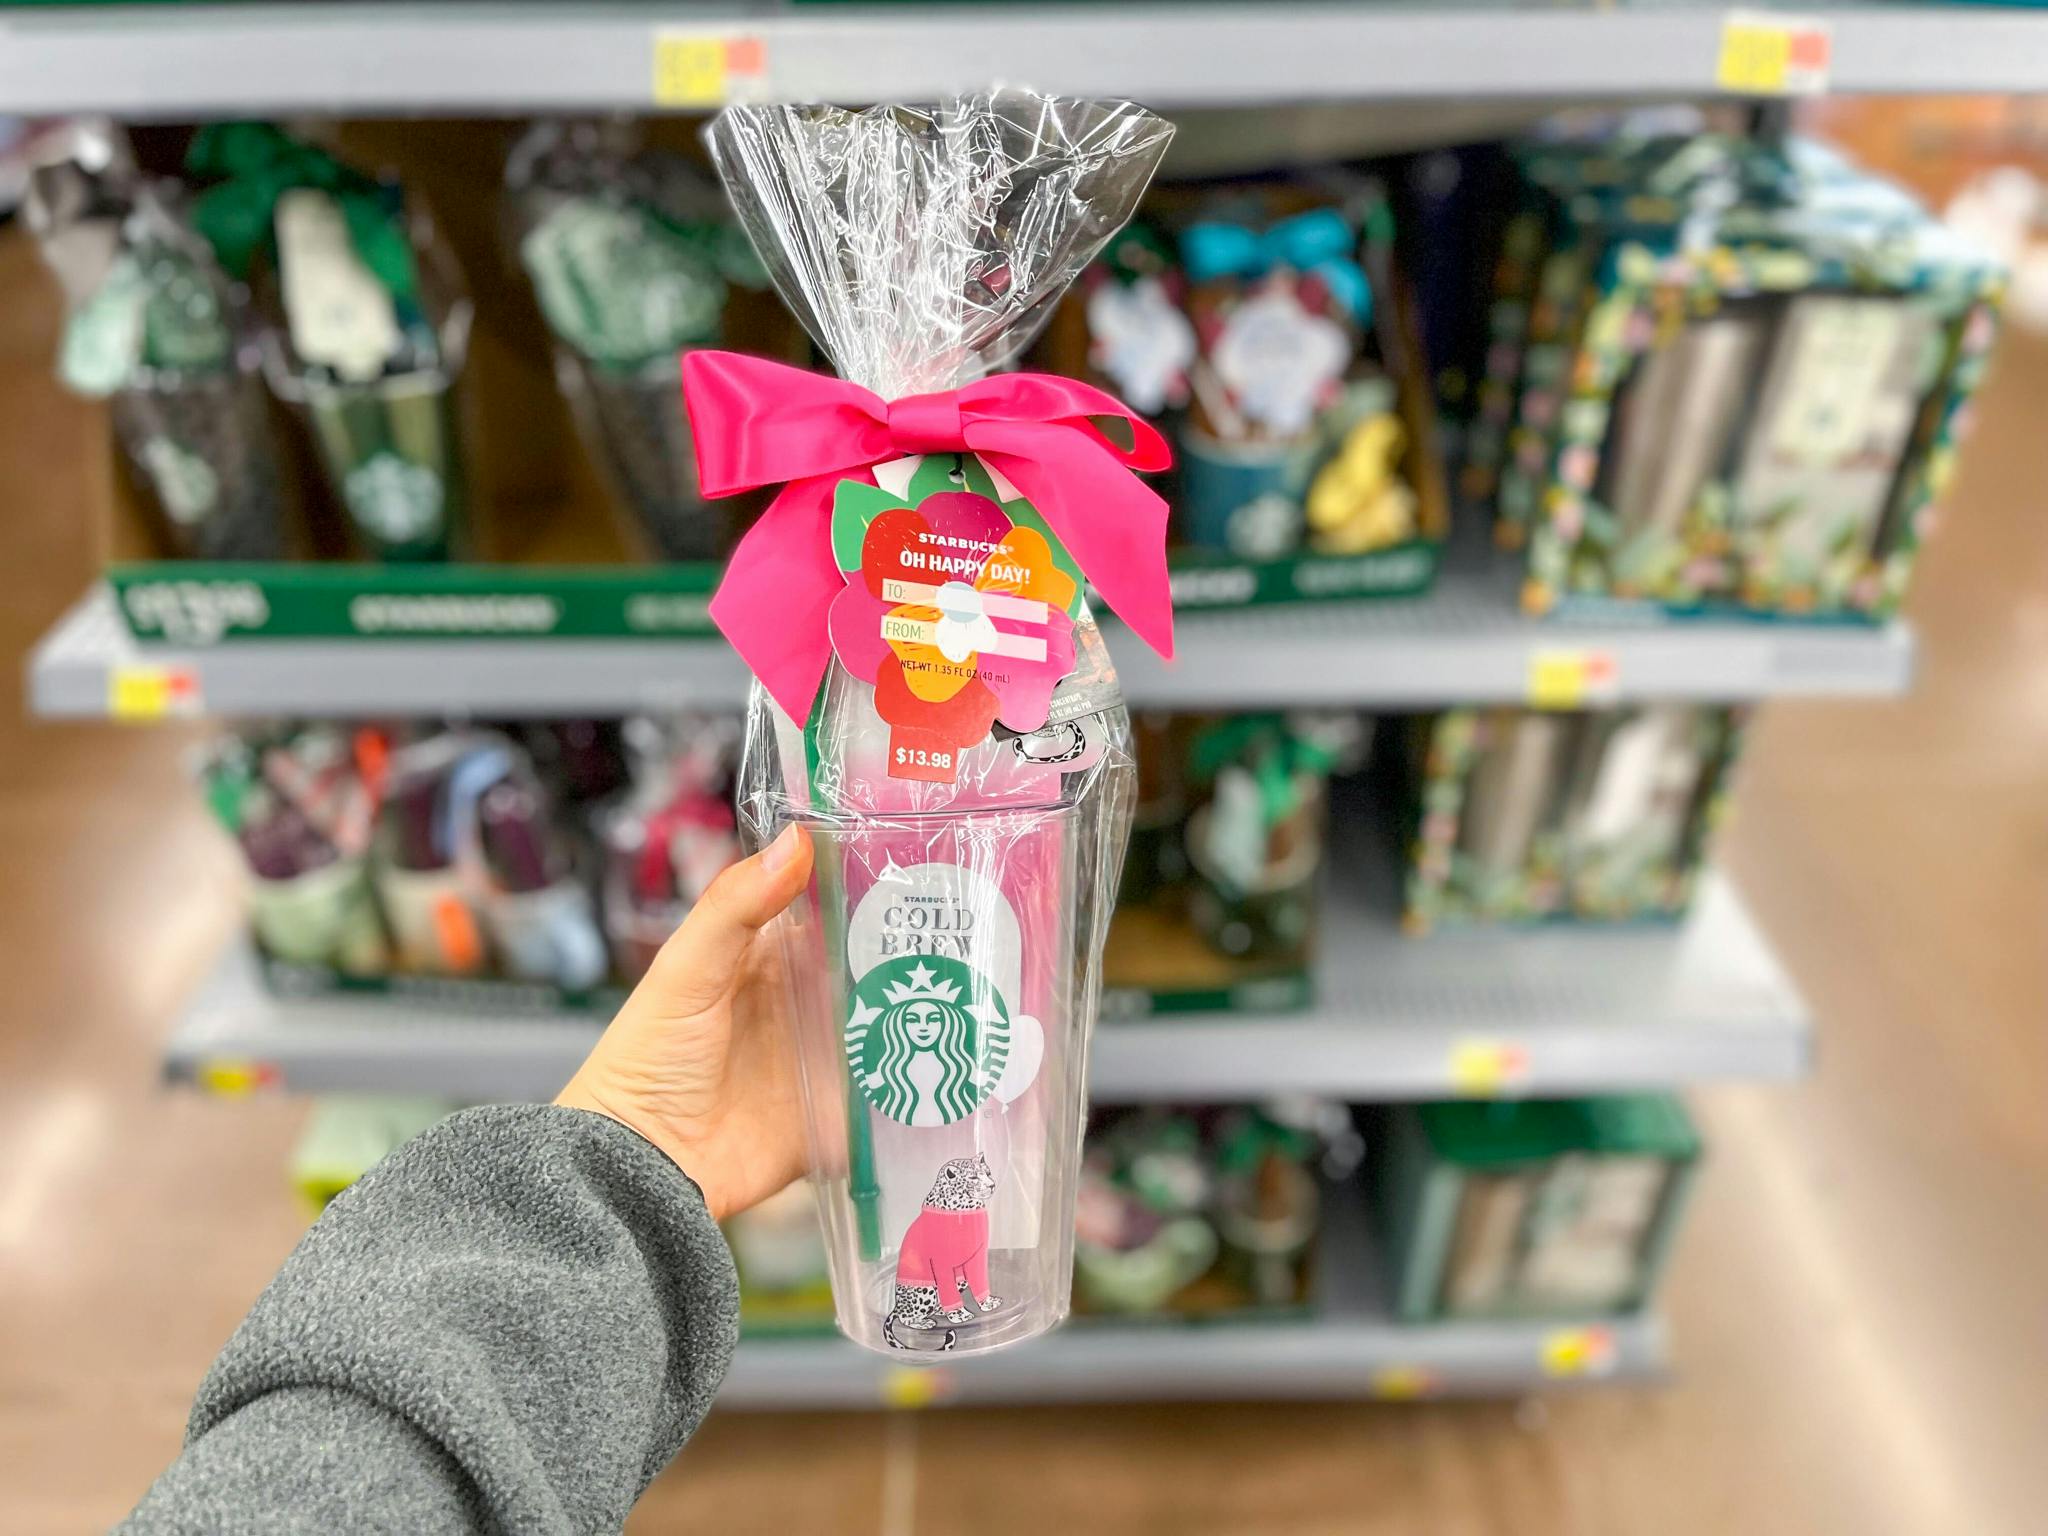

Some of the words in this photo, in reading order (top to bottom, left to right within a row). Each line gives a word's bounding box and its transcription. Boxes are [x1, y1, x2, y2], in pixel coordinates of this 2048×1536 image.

[918, 532, 1009, 555] STARBUCKS
[900, 550, 926, 569] OH
[929, 554, 985, 577] HAPPY
[990, 563, 1031, 584] DAY!
[886, 583, 907, 600] TO:
[885, 620, 925, 641] FROM:
[900, 659, 917, 671] NET
[919, 662, 932, 672] WT
[934, 664, 952, 675] 1.35
[954, 667, 964, 677] FL
[966, 668, 978, 679] OZ
[980, 671, 993, 682] (40
[895, 746, 952, 769] $13.98
[904, 896, 956, 904] STARBUCS
[884, 906, 975, 931] COLD
[879, 933, 976, 958] BREW
